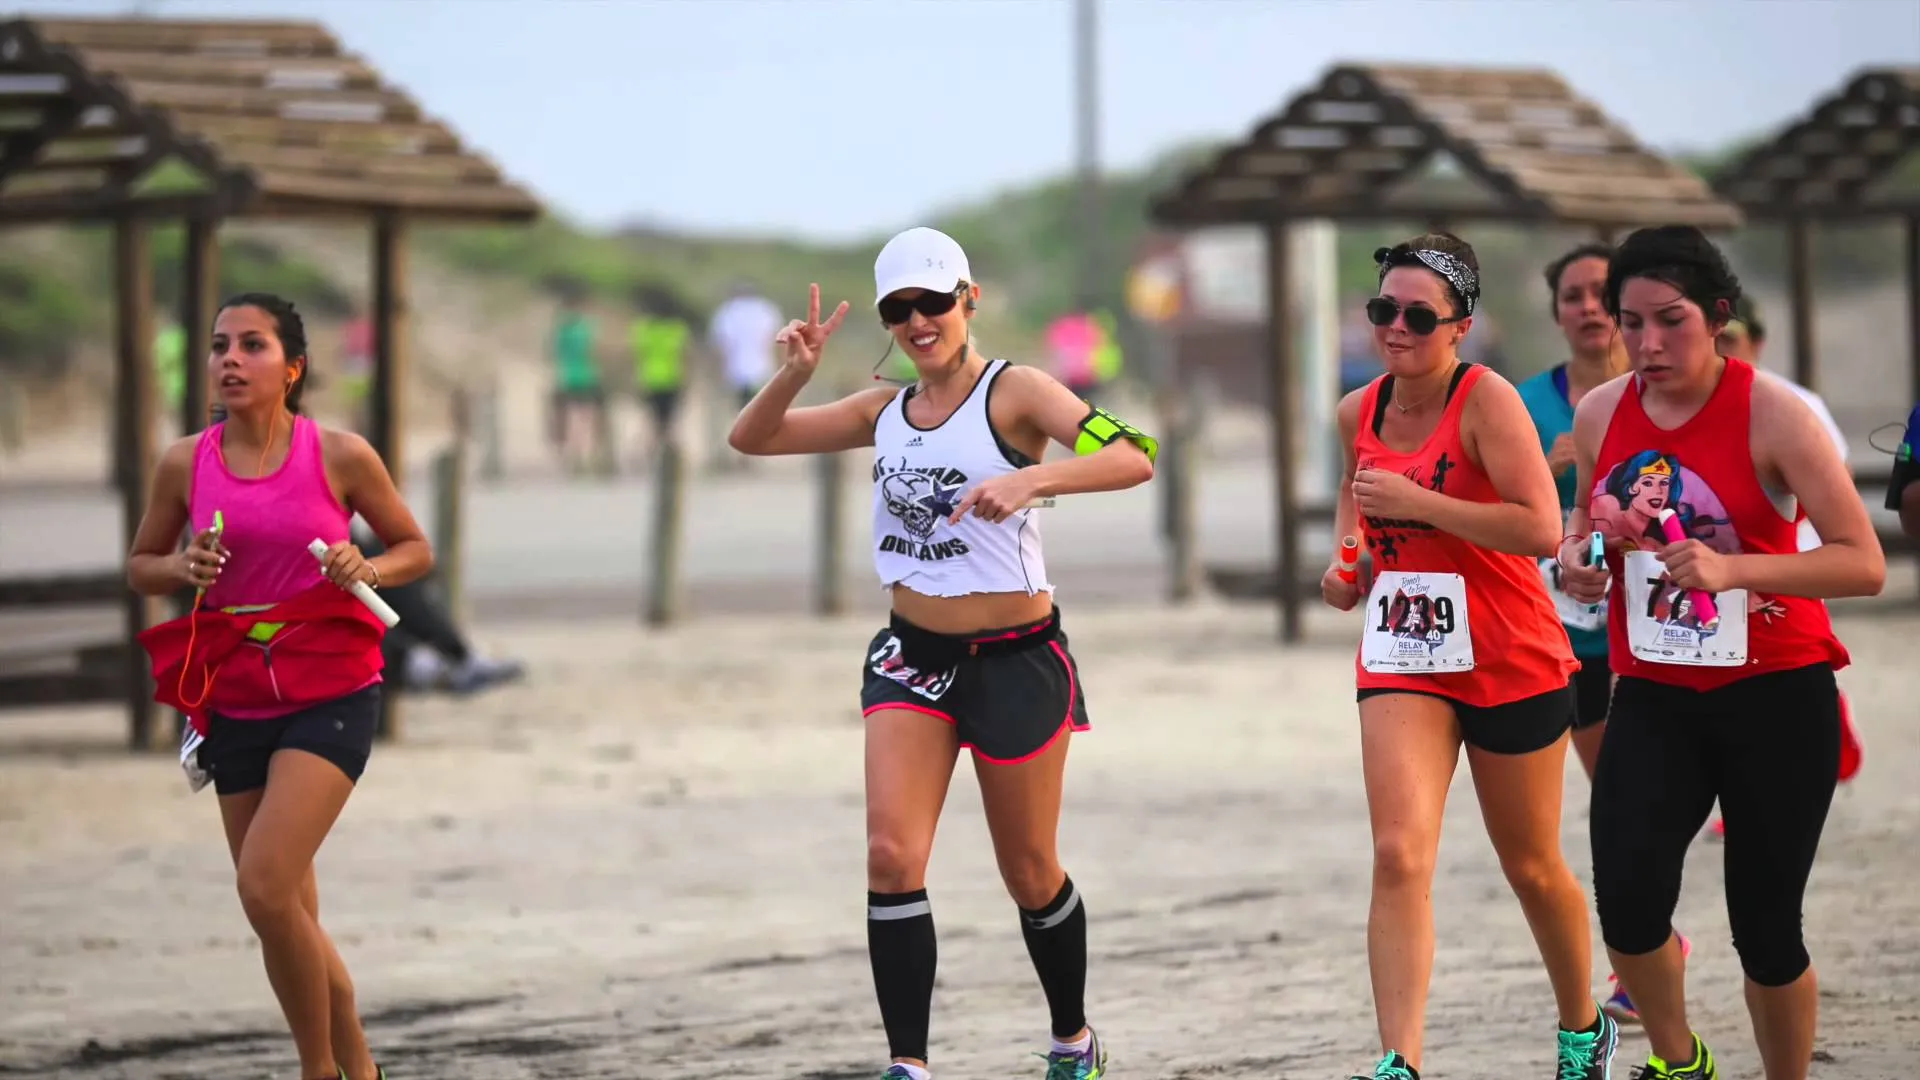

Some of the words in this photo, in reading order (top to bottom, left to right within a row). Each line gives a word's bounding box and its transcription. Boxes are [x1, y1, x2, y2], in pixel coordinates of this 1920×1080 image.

[879, 534, 970, 561] OUTLAWS
[1376, 595, 1455, 634] 1239
[1426, 630, 1441, 640] 40
[1664, 629, 1693, 638] RELAY
